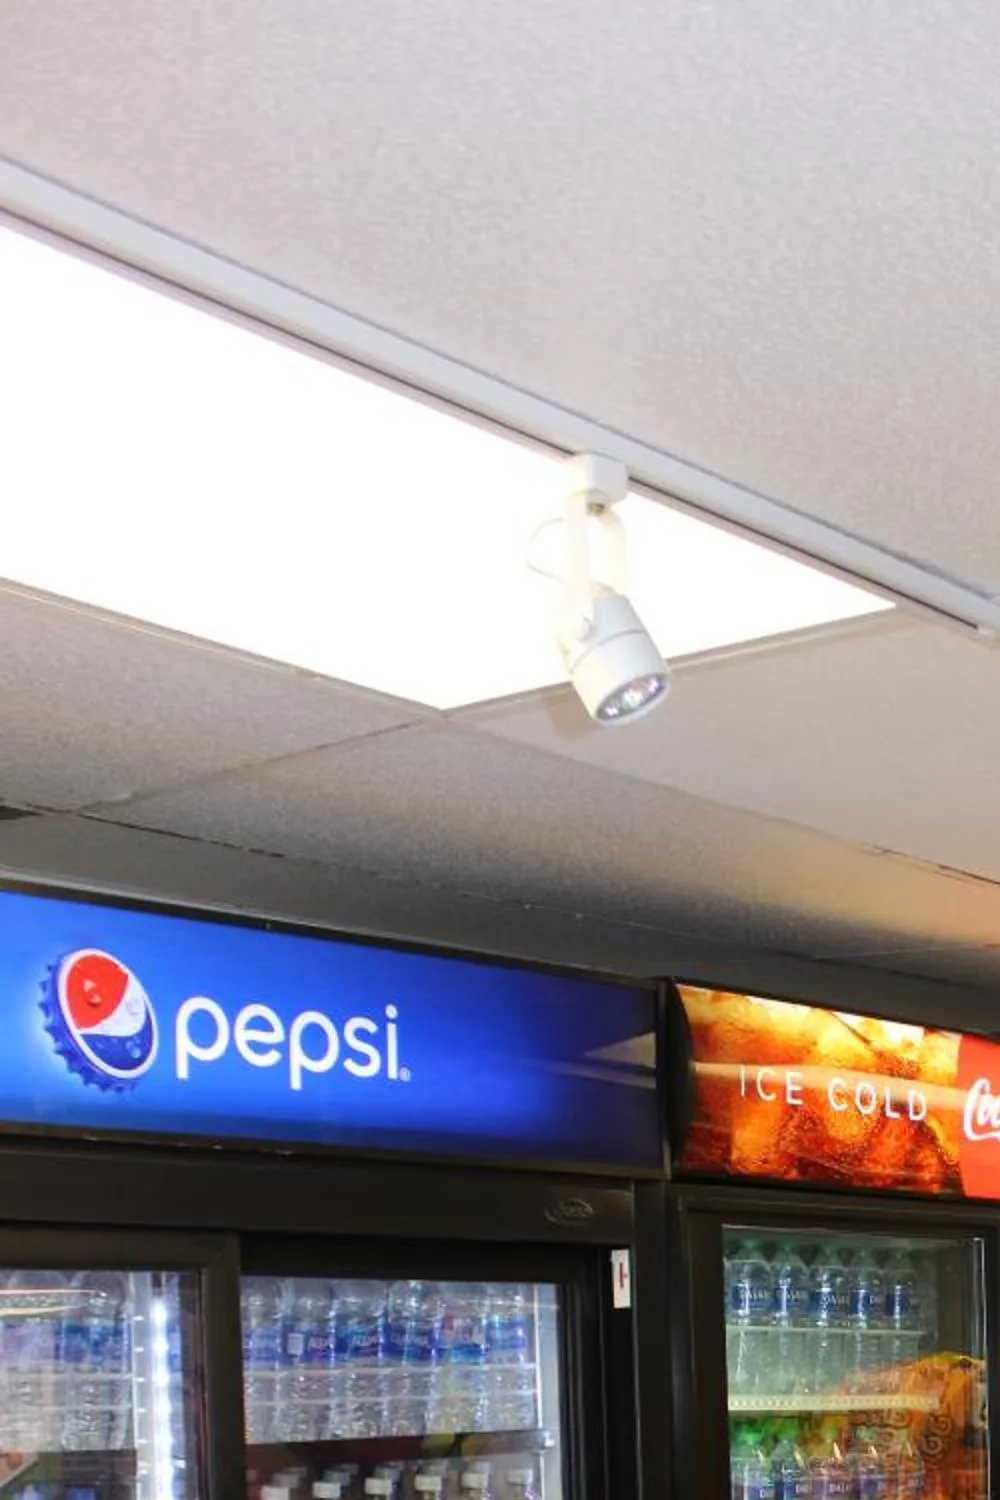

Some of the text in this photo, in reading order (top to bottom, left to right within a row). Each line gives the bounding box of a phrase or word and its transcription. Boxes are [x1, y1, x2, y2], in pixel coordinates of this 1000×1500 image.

[175, 996, 402, 1091] pepsi
[739, 1066, 928, 1122] ICE COLD
